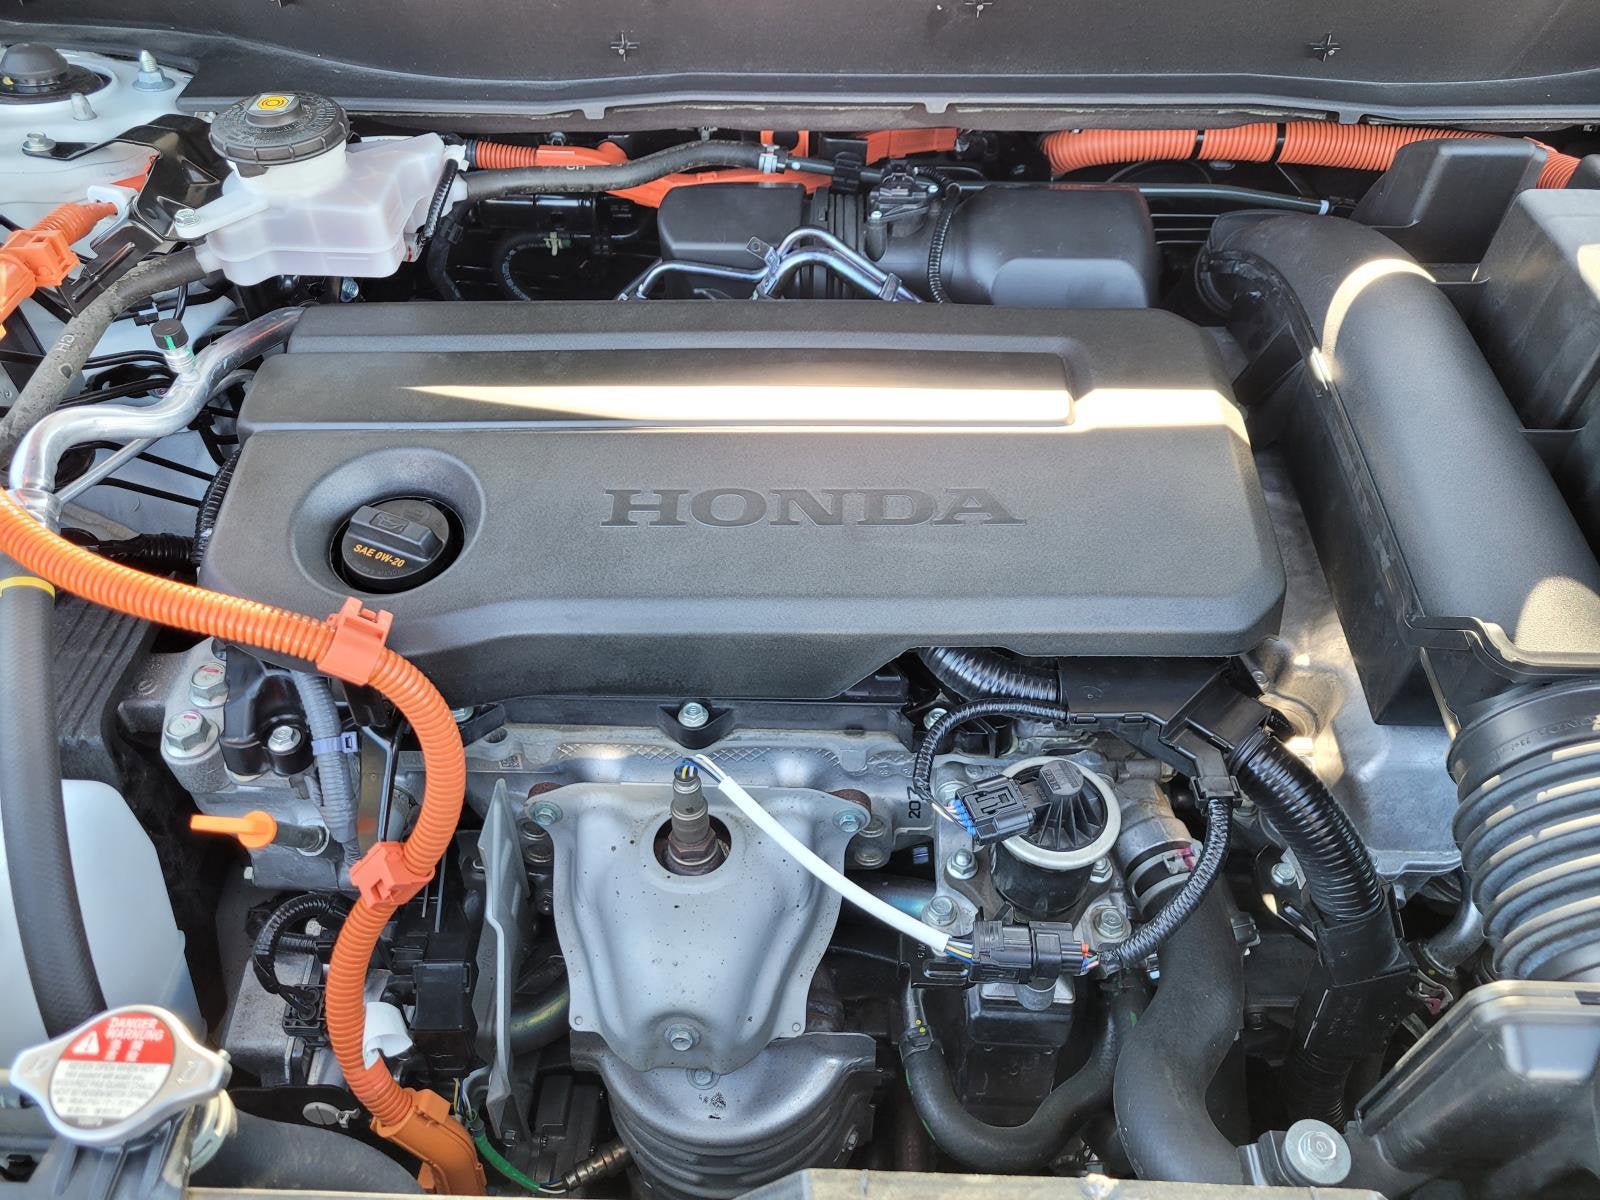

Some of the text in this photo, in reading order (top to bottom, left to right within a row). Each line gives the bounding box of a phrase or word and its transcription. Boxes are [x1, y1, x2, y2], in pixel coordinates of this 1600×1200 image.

[600, 488, 1027, 528] HONDA
[353, 544, 406, 567] SAE 0W-20
[109, 1017, 158, 1029] DANGER
